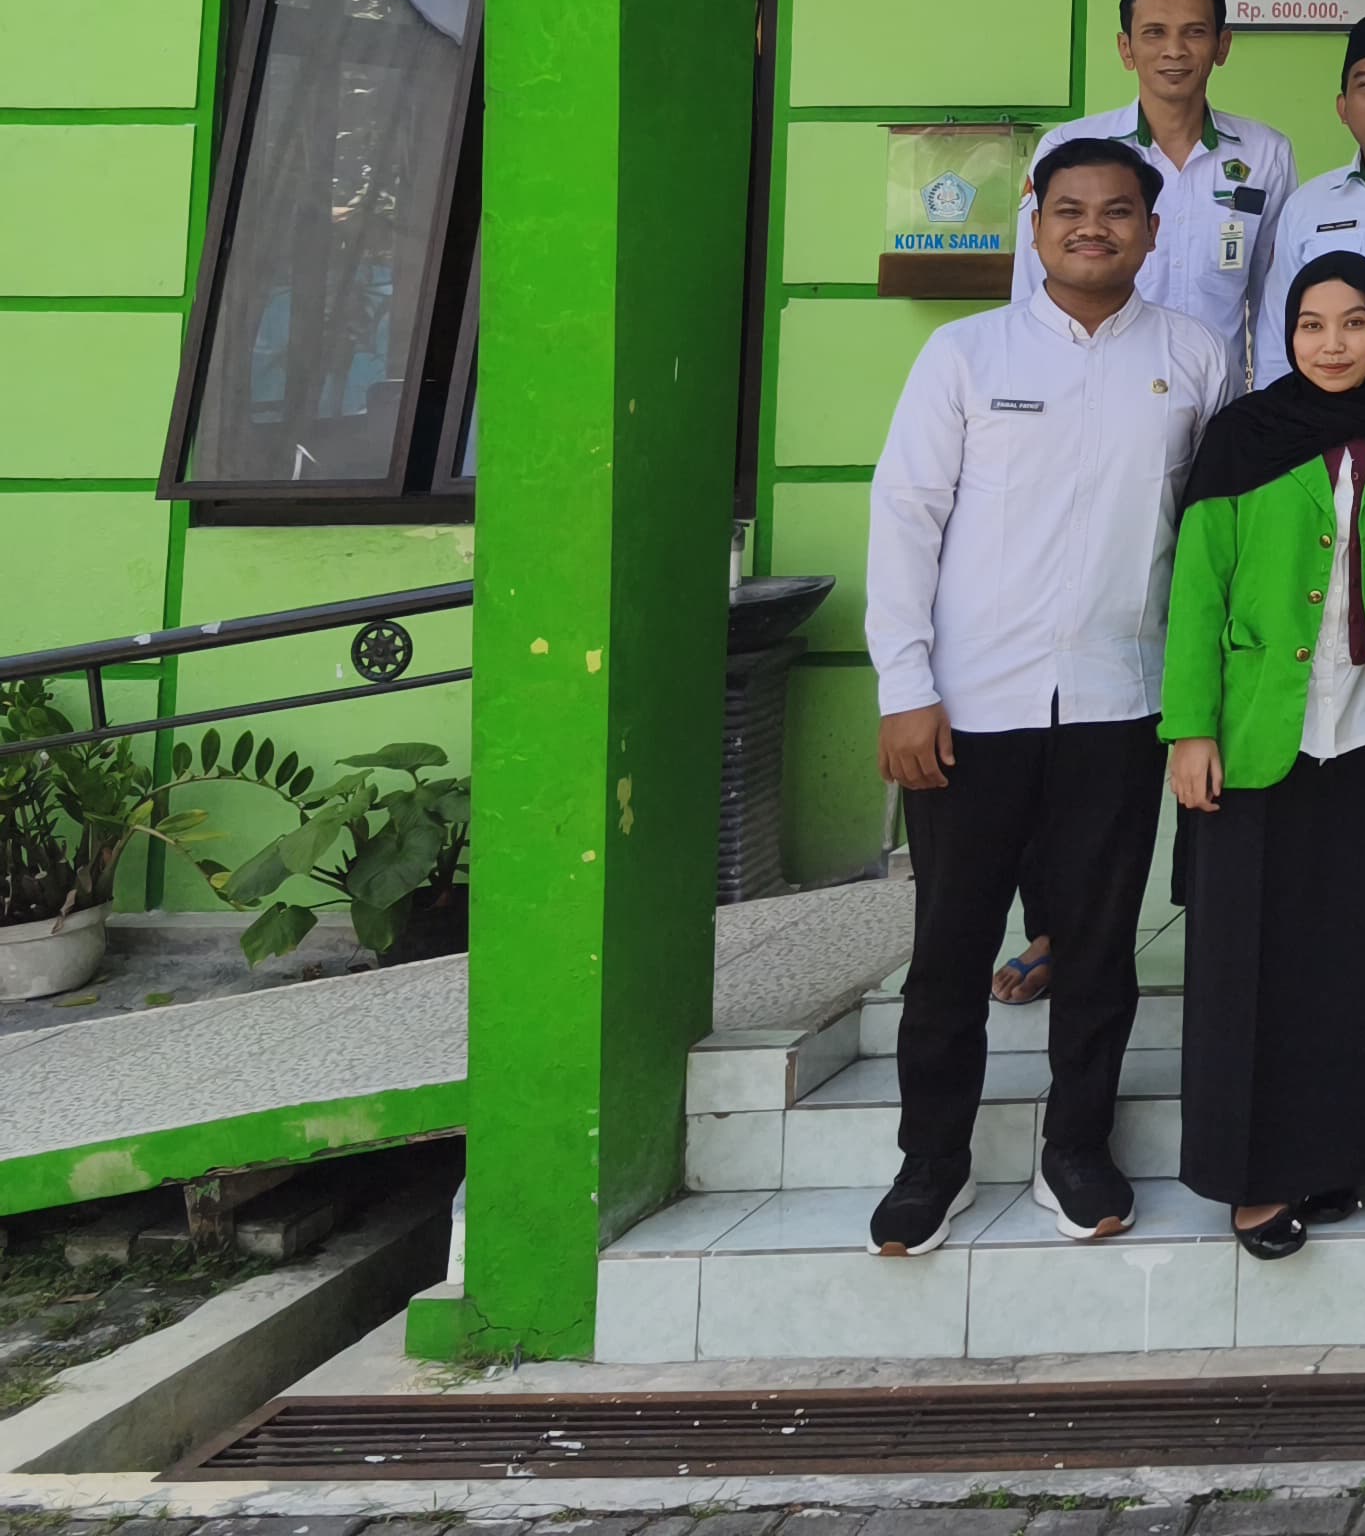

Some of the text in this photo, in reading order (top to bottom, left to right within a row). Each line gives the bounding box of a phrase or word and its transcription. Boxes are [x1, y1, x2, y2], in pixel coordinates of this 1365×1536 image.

[1236, 1, 1349, 22] Rp. 600.000,-
[895, 234, 1000, 249] KOTAK SARAN
